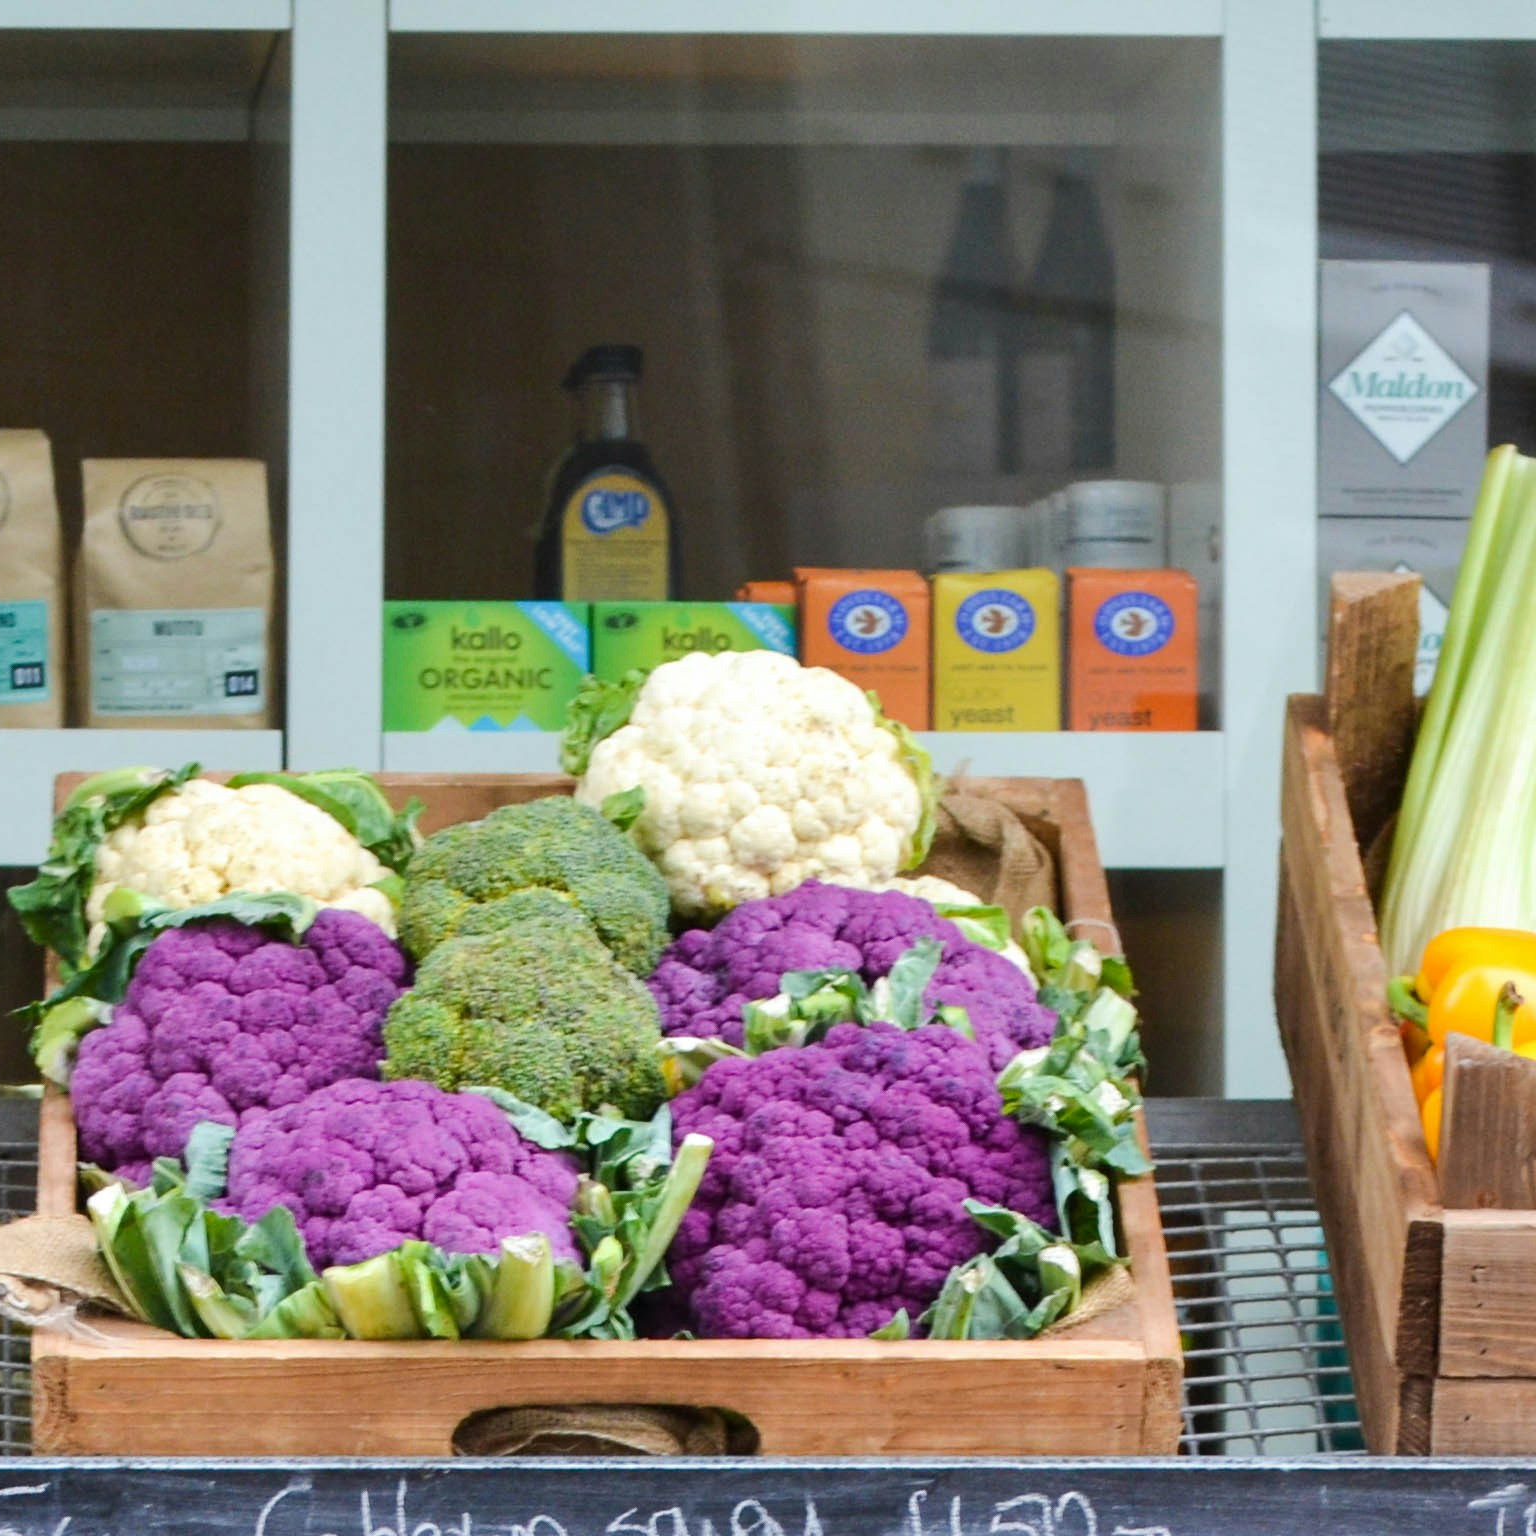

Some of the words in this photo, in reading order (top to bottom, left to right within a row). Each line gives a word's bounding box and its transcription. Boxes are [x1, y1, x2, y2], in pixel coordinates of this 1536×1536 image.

[1345, 371, 1465, 400] Maldon
[449, 624, 522, 651] kallo
[661, 626, 733, 652] kallo
[418, 667, 553, 691] ORGANIC
[948, 706, 1016, 728] yeast
[1087, 707, 1152, 730] yeast
